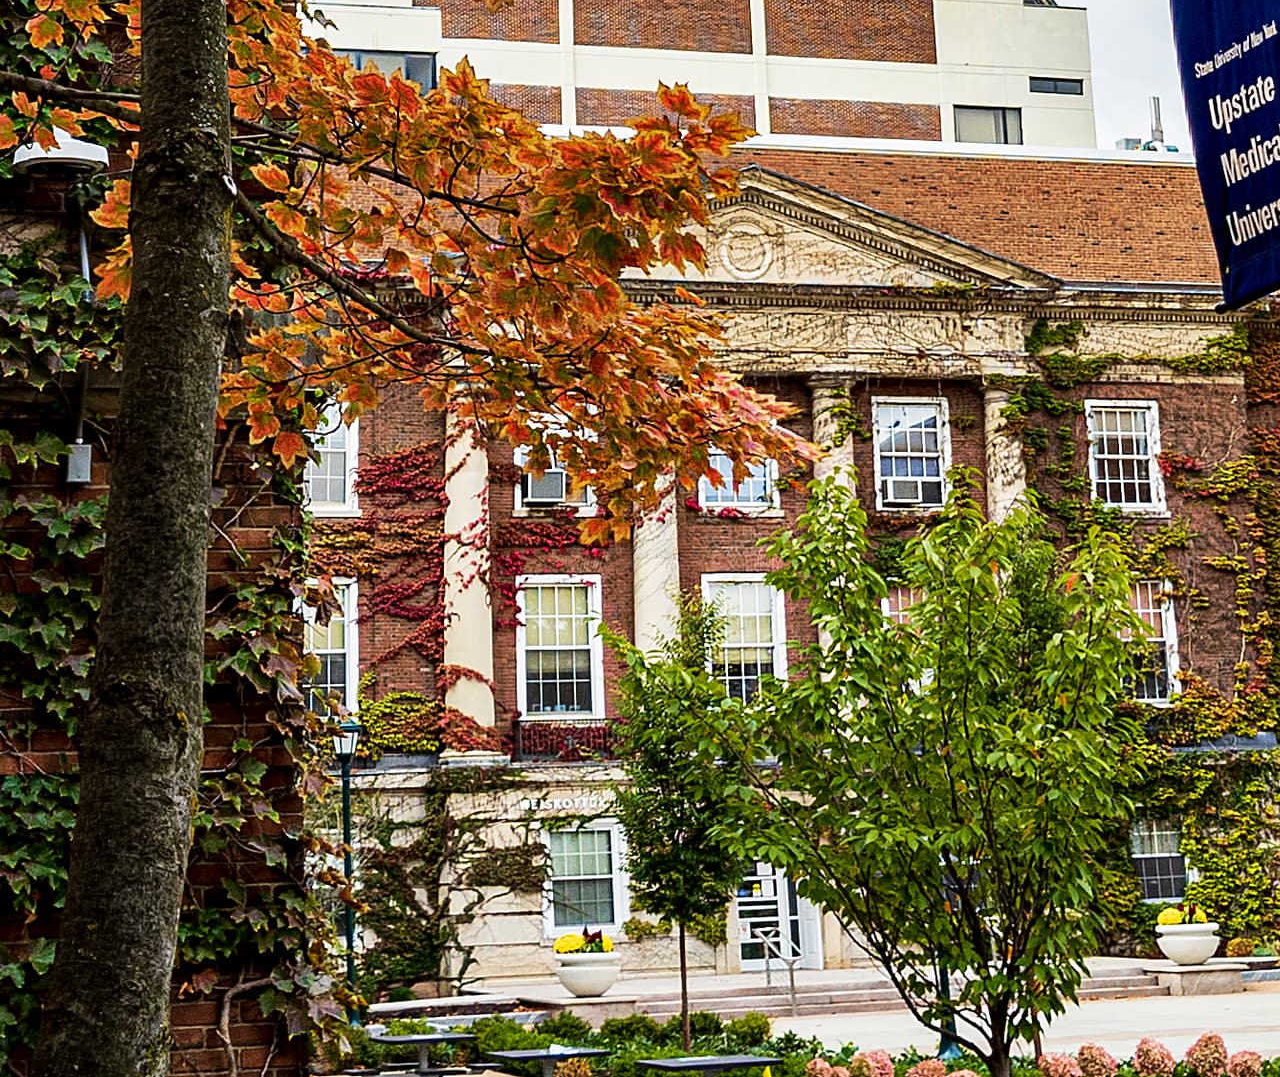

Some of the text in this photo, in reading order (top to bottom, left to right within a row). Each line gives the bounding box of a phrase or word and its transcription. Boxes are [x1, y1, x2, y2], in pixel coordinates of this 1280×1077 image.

[1194, 60, 1214, 78] State
[1213, 42, 1242, 69] University
[1242, 34, 1250, 52] of
[1208, 75, 1276, 134] Upstate
